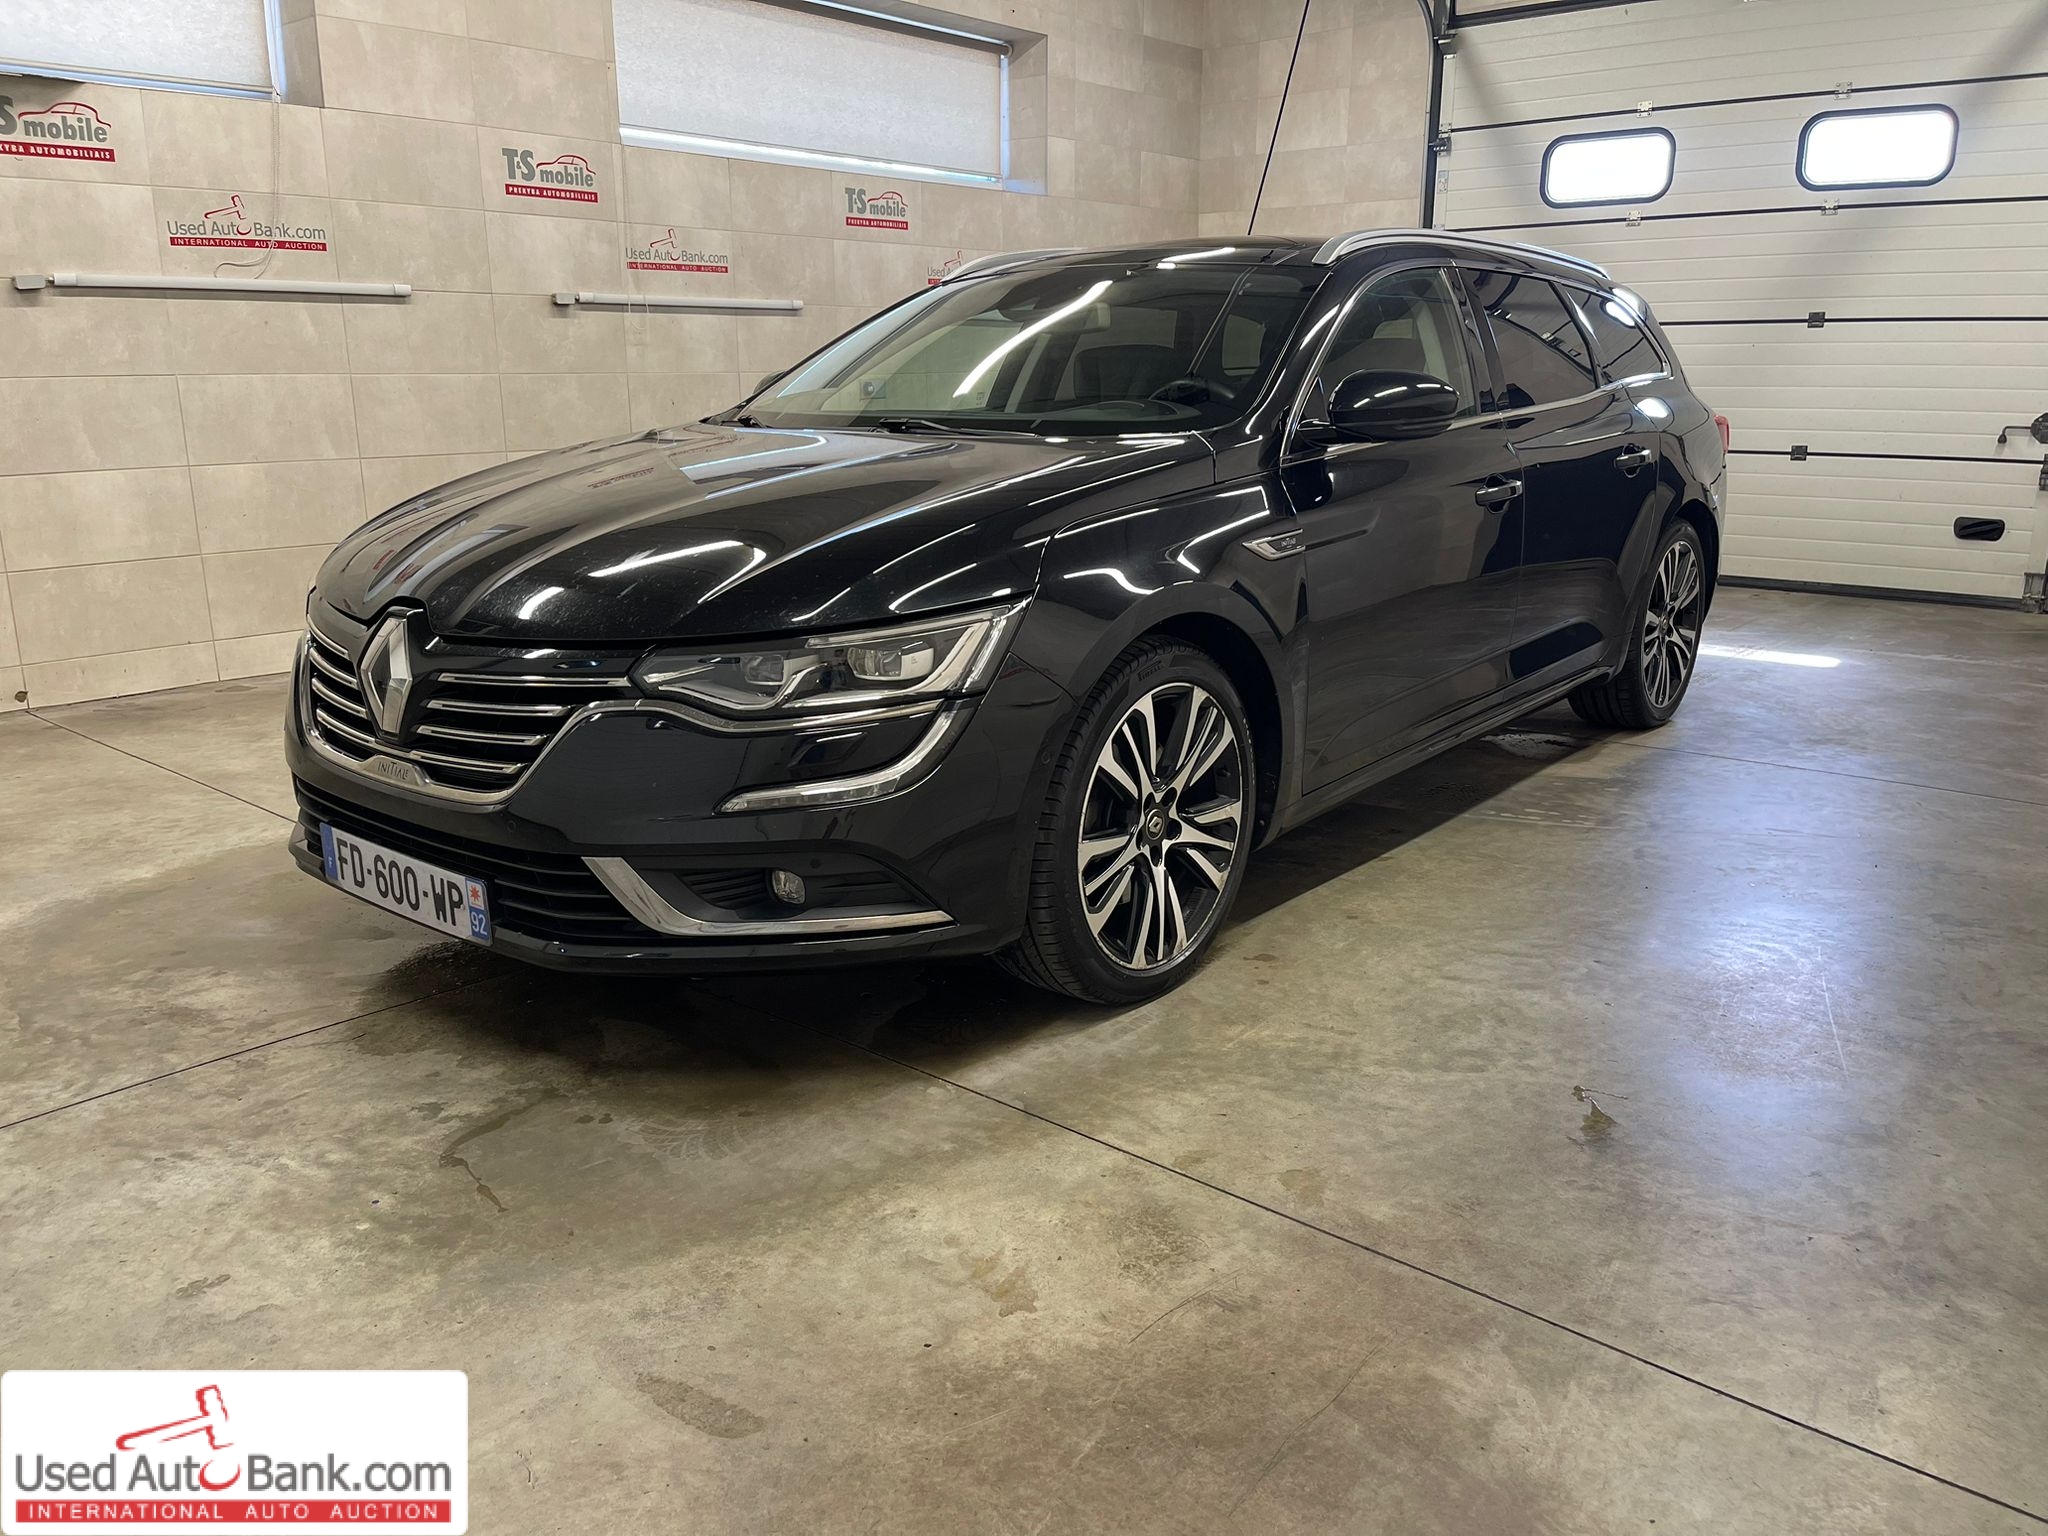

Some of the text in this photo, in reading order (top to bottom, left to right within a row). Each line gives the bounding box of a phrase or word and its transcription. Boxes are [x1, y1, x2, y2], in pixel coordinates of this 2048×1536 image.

[0, 95, 108, 142] S mobile
[30, 145, 110, 159] AUTOMOBILIAIS
[539, 165, 593, 187] mobile
[508, 186, 595, 200] PREKYBA AUTOMOBILIAIS
[869, 200, 906, 217] mobile
[167, 220, 206, 236] Used
[253, 222, 326, 240] Bank.com
[174, 238, 323, 250] INTERNATIONAL AUTO AUCTION
[625, 247, 651, 260] Used
[681, 250, 728, 263] Bank.com
[336, 837, 463, 926] FD-600-WP
[471, 911, 487, 935] 92
